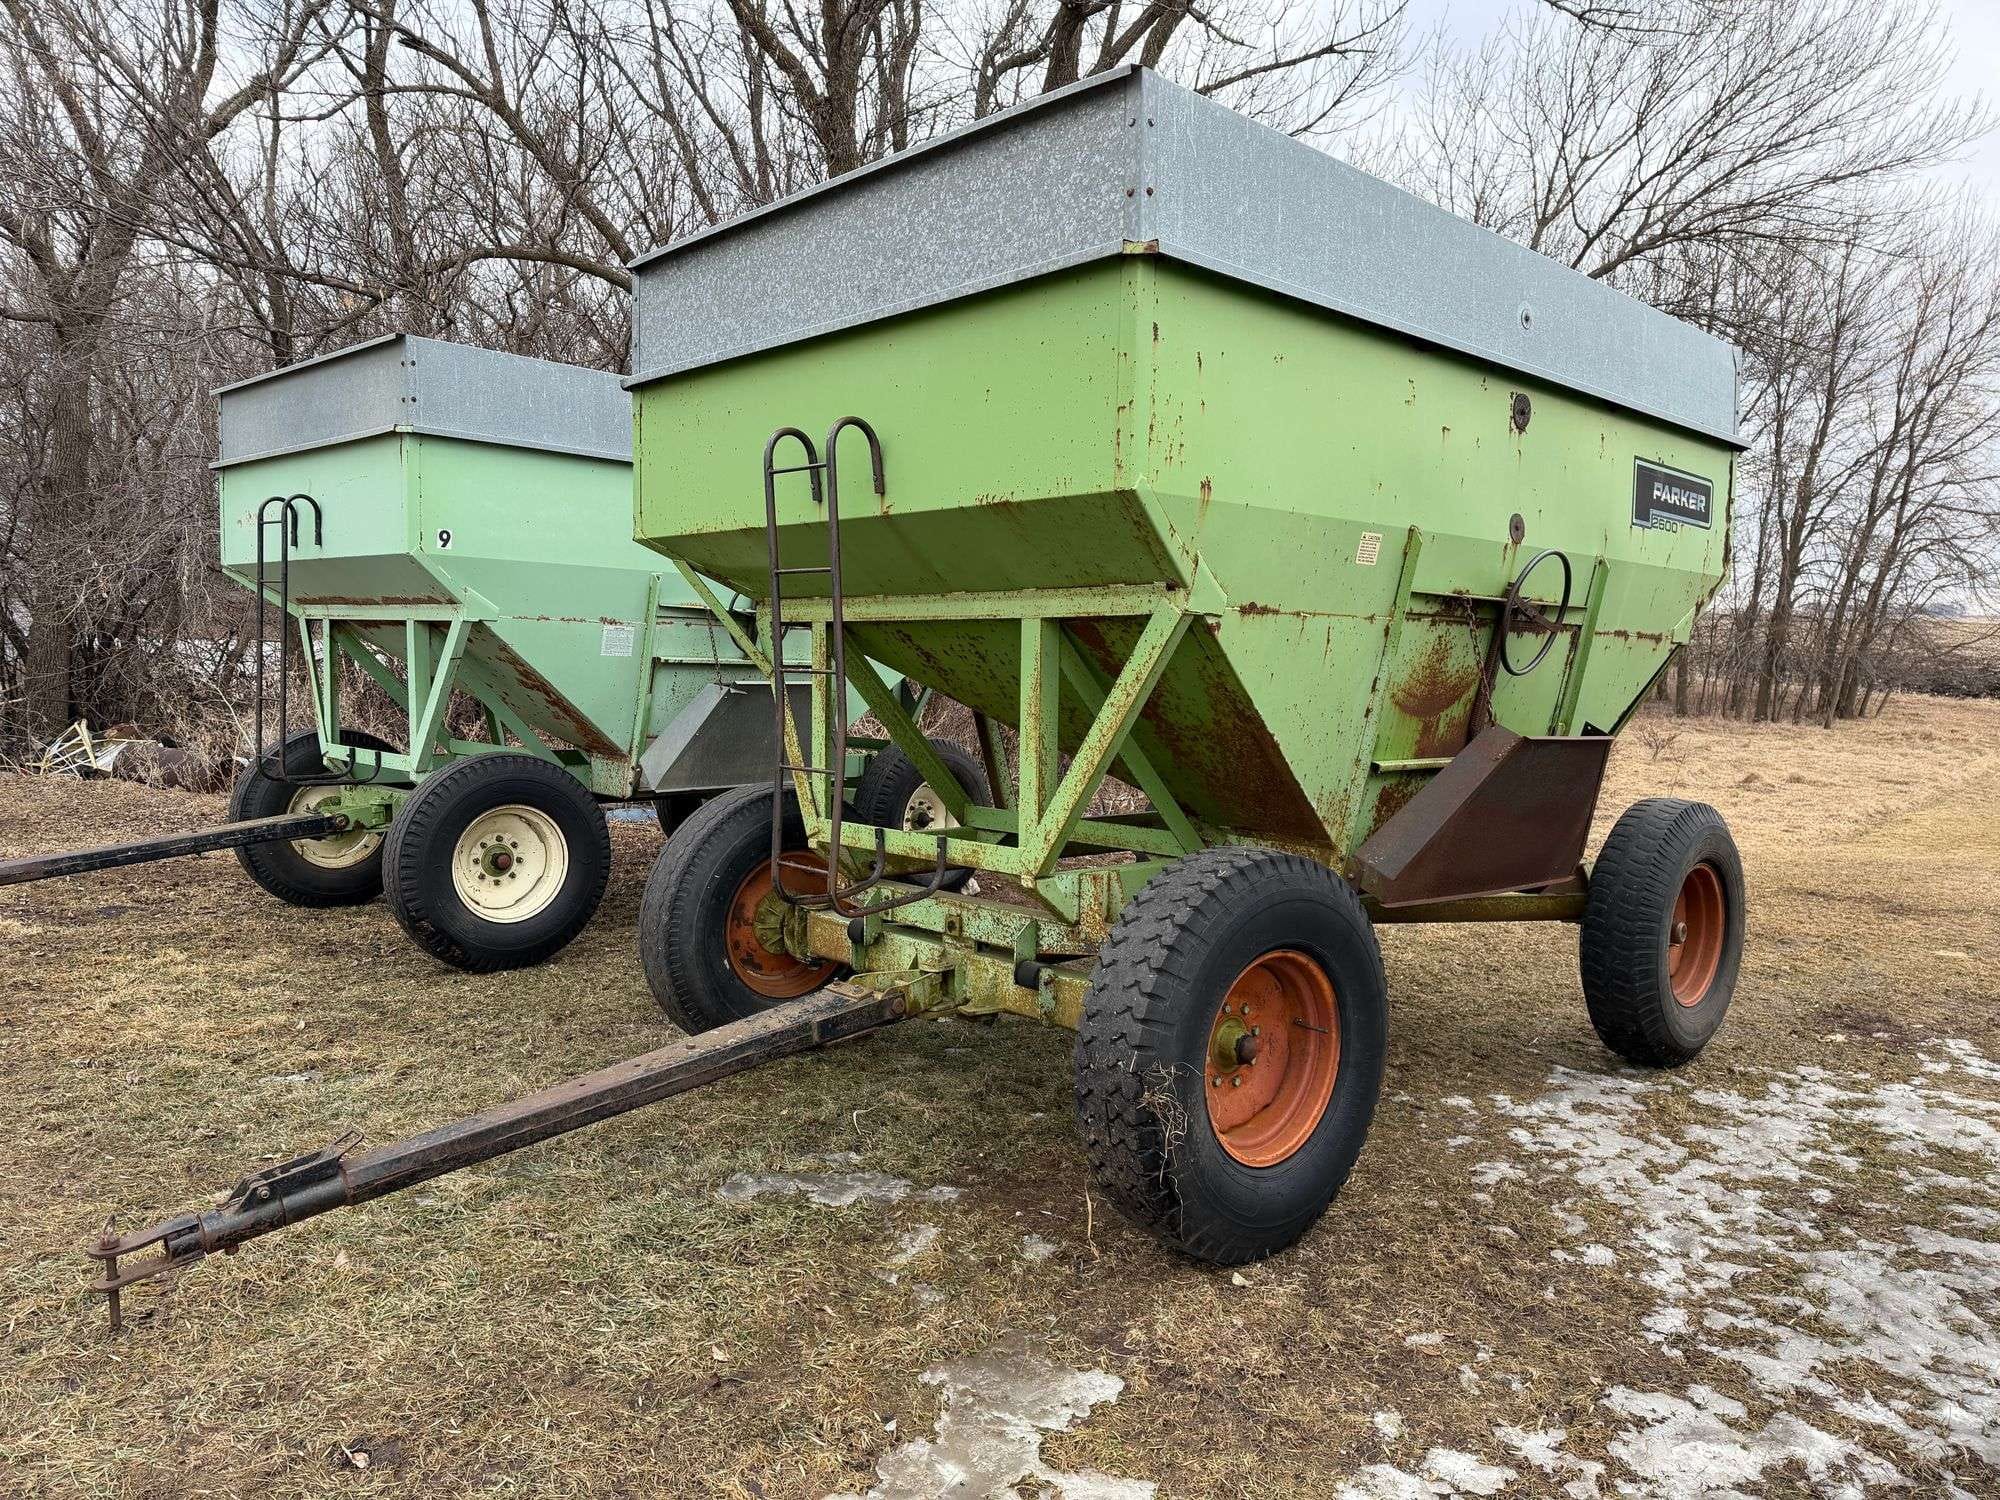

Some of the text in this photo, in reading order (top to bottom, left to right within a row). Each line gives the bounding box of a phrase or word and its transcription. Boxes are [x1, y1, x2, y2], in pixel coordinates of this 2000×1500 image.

[1653, 482, 1705, 512] PARKER
[1652, 516, 1678, 534] 2600
[438, 529, 452, 548] 9
